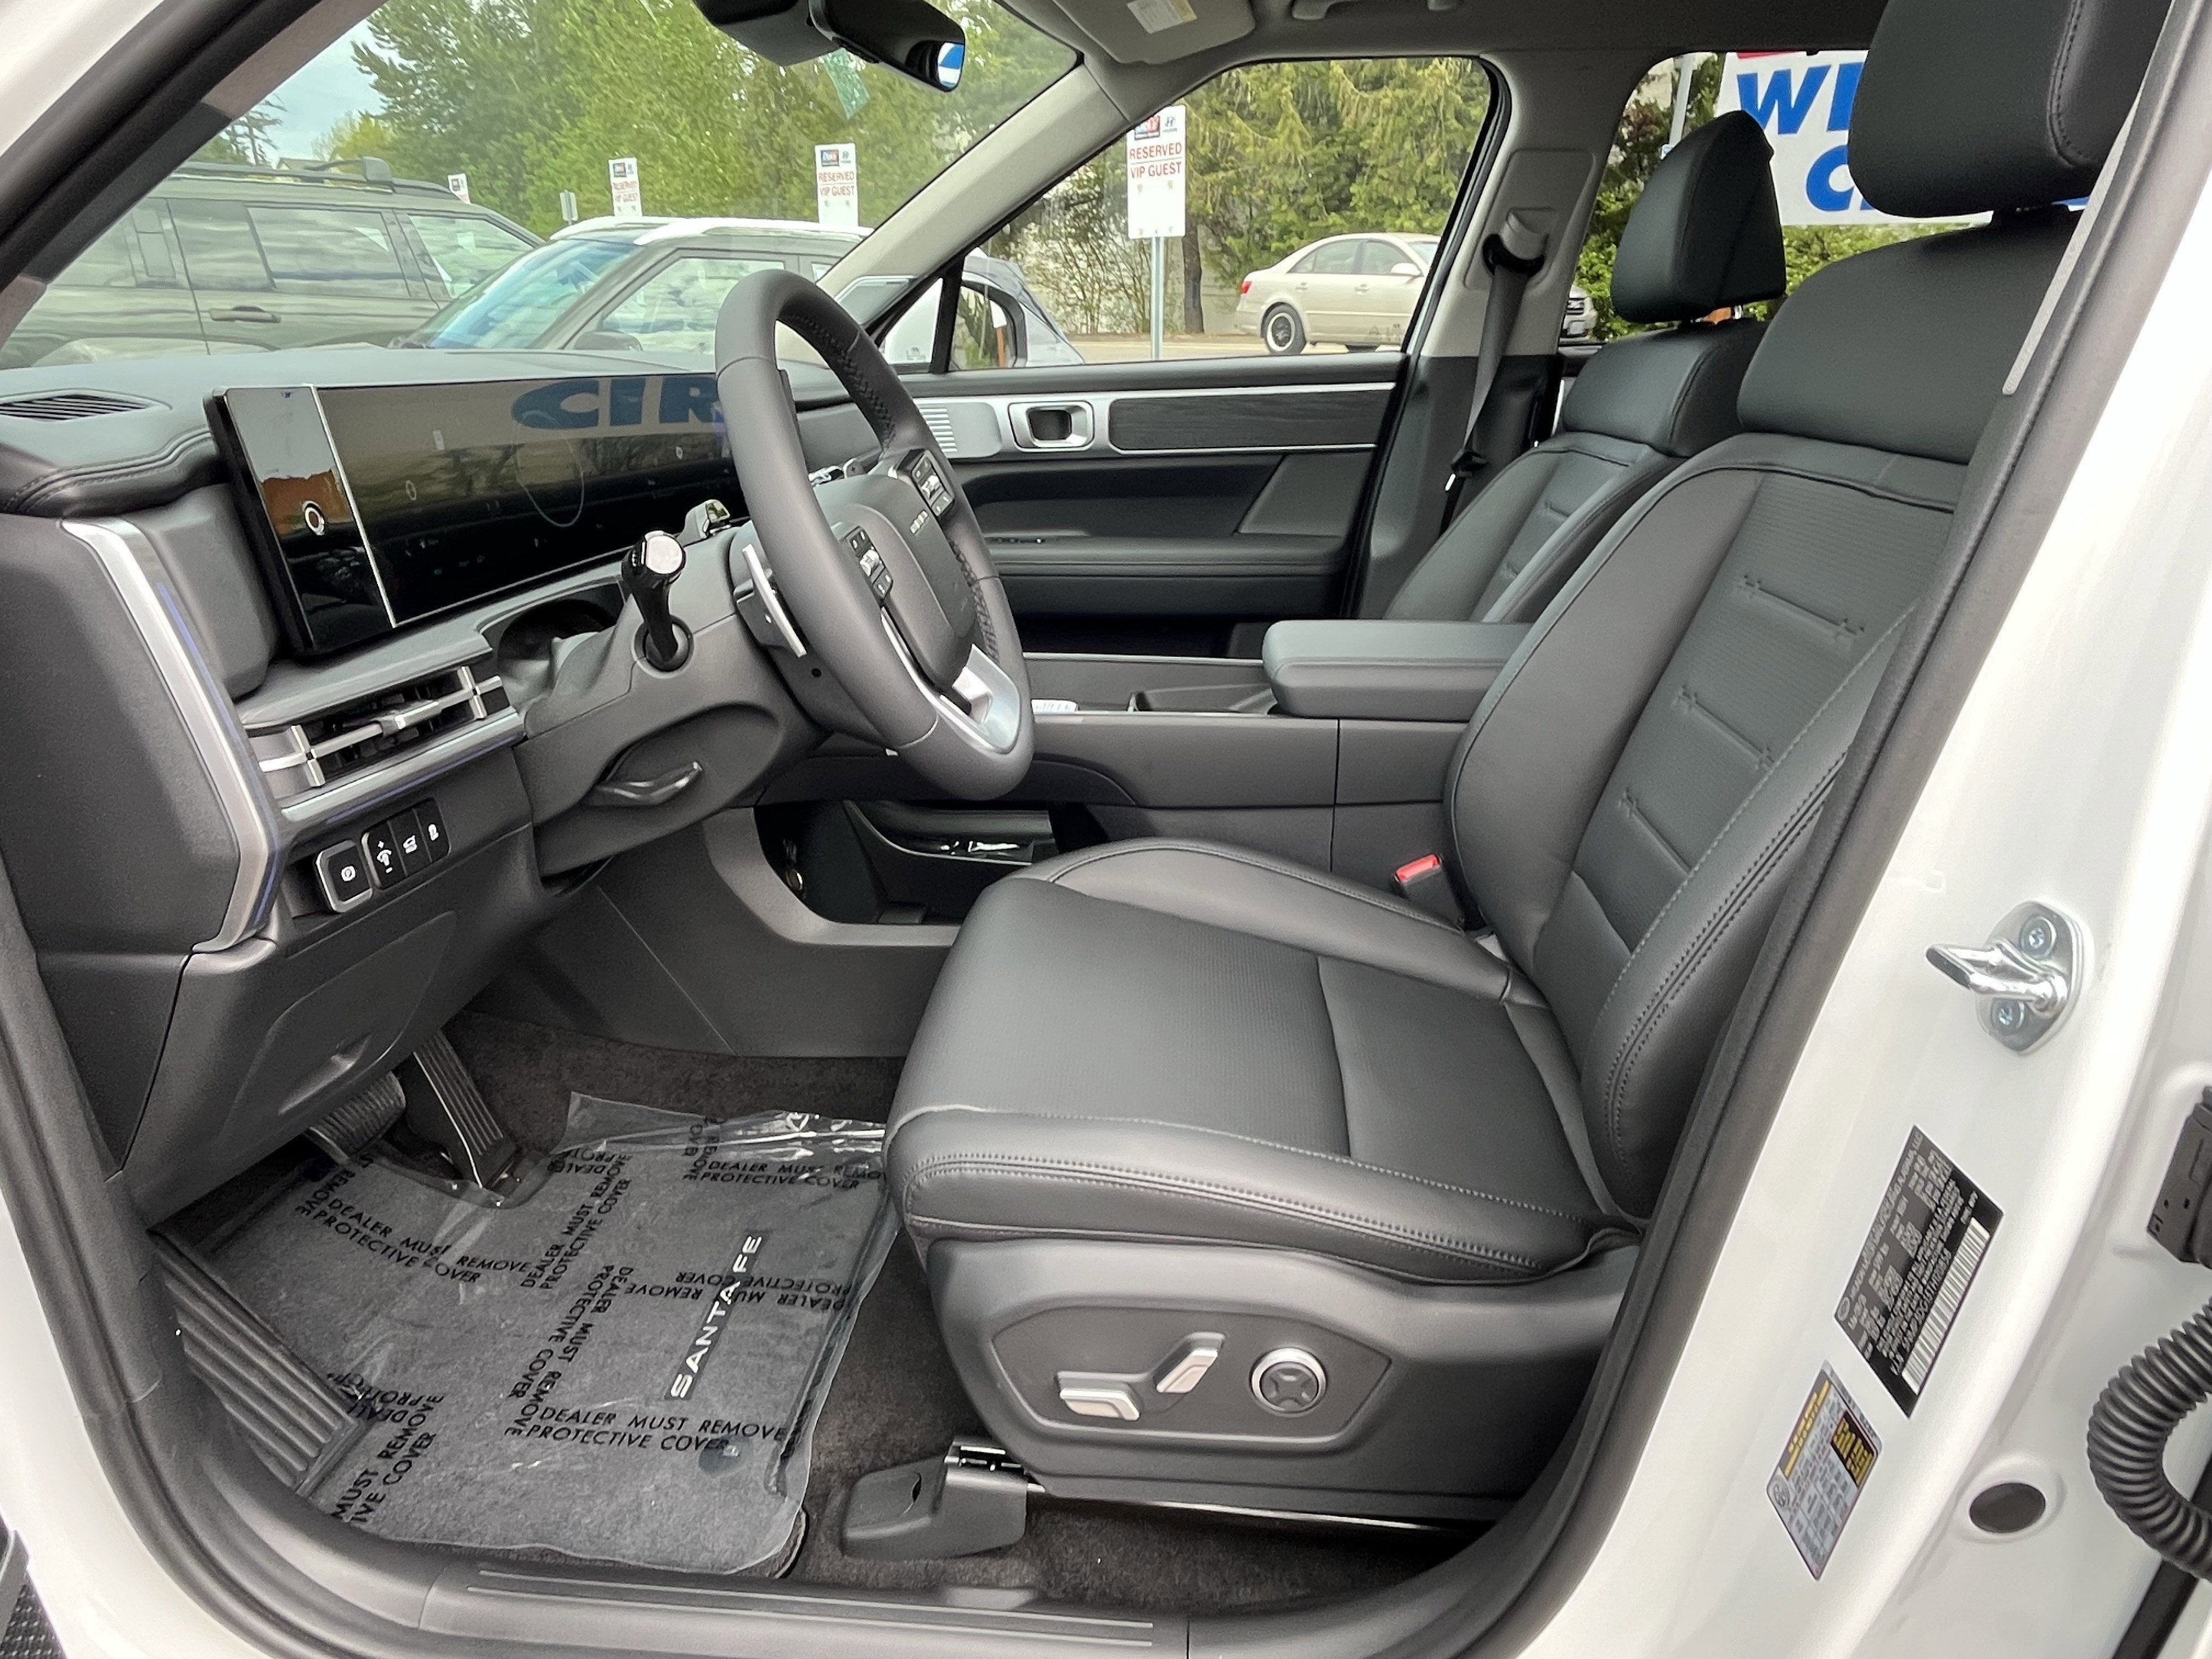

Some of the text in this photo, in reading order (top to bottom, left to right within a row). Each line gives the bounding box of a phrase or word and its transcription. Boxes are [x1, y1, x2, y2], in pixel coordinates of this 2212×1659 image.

[1129, 142, 1182, 160] RESERVED
[818, 171, 855, 182] RESERVED
[1130, 161, 1182, 179] VIP GUEST
[820, 185, 855, 196] VIP GUEST
[701, 1172, 860, 1189] PROTECTIVE COVER
[708, 1161, 768, 1173] DEALER
[312, 1210, 482, 1283] PROTECTIVE COVER
[328, 1199, 531, 1272] DEALER MUST REMOVE
[521, 1244, 565, 1288] DEALER
[562, 1203, 594, 1235] MUST
[539, 1219, 603, 1289] PROTECTIVE
[623, 1283, 704, 1300] REMOVE
[777, 1294, 847, 1311] DEALER
[507, 1265, 615, 1398] PROTECTIVE COVER
[670, 1235, 763, 1398] SANTA FE
[504, 1266, 634, 1436] DEALER MUST REMOVE
[526, 1424, 730, 1452] PROTECTIVE COVER
[539, 1407, 788, 1441] DEALER MUST REMOVE
[330, 1395, 444, 1520] MUST REMOVE
[382, 1432, 437, 1485] COVER
